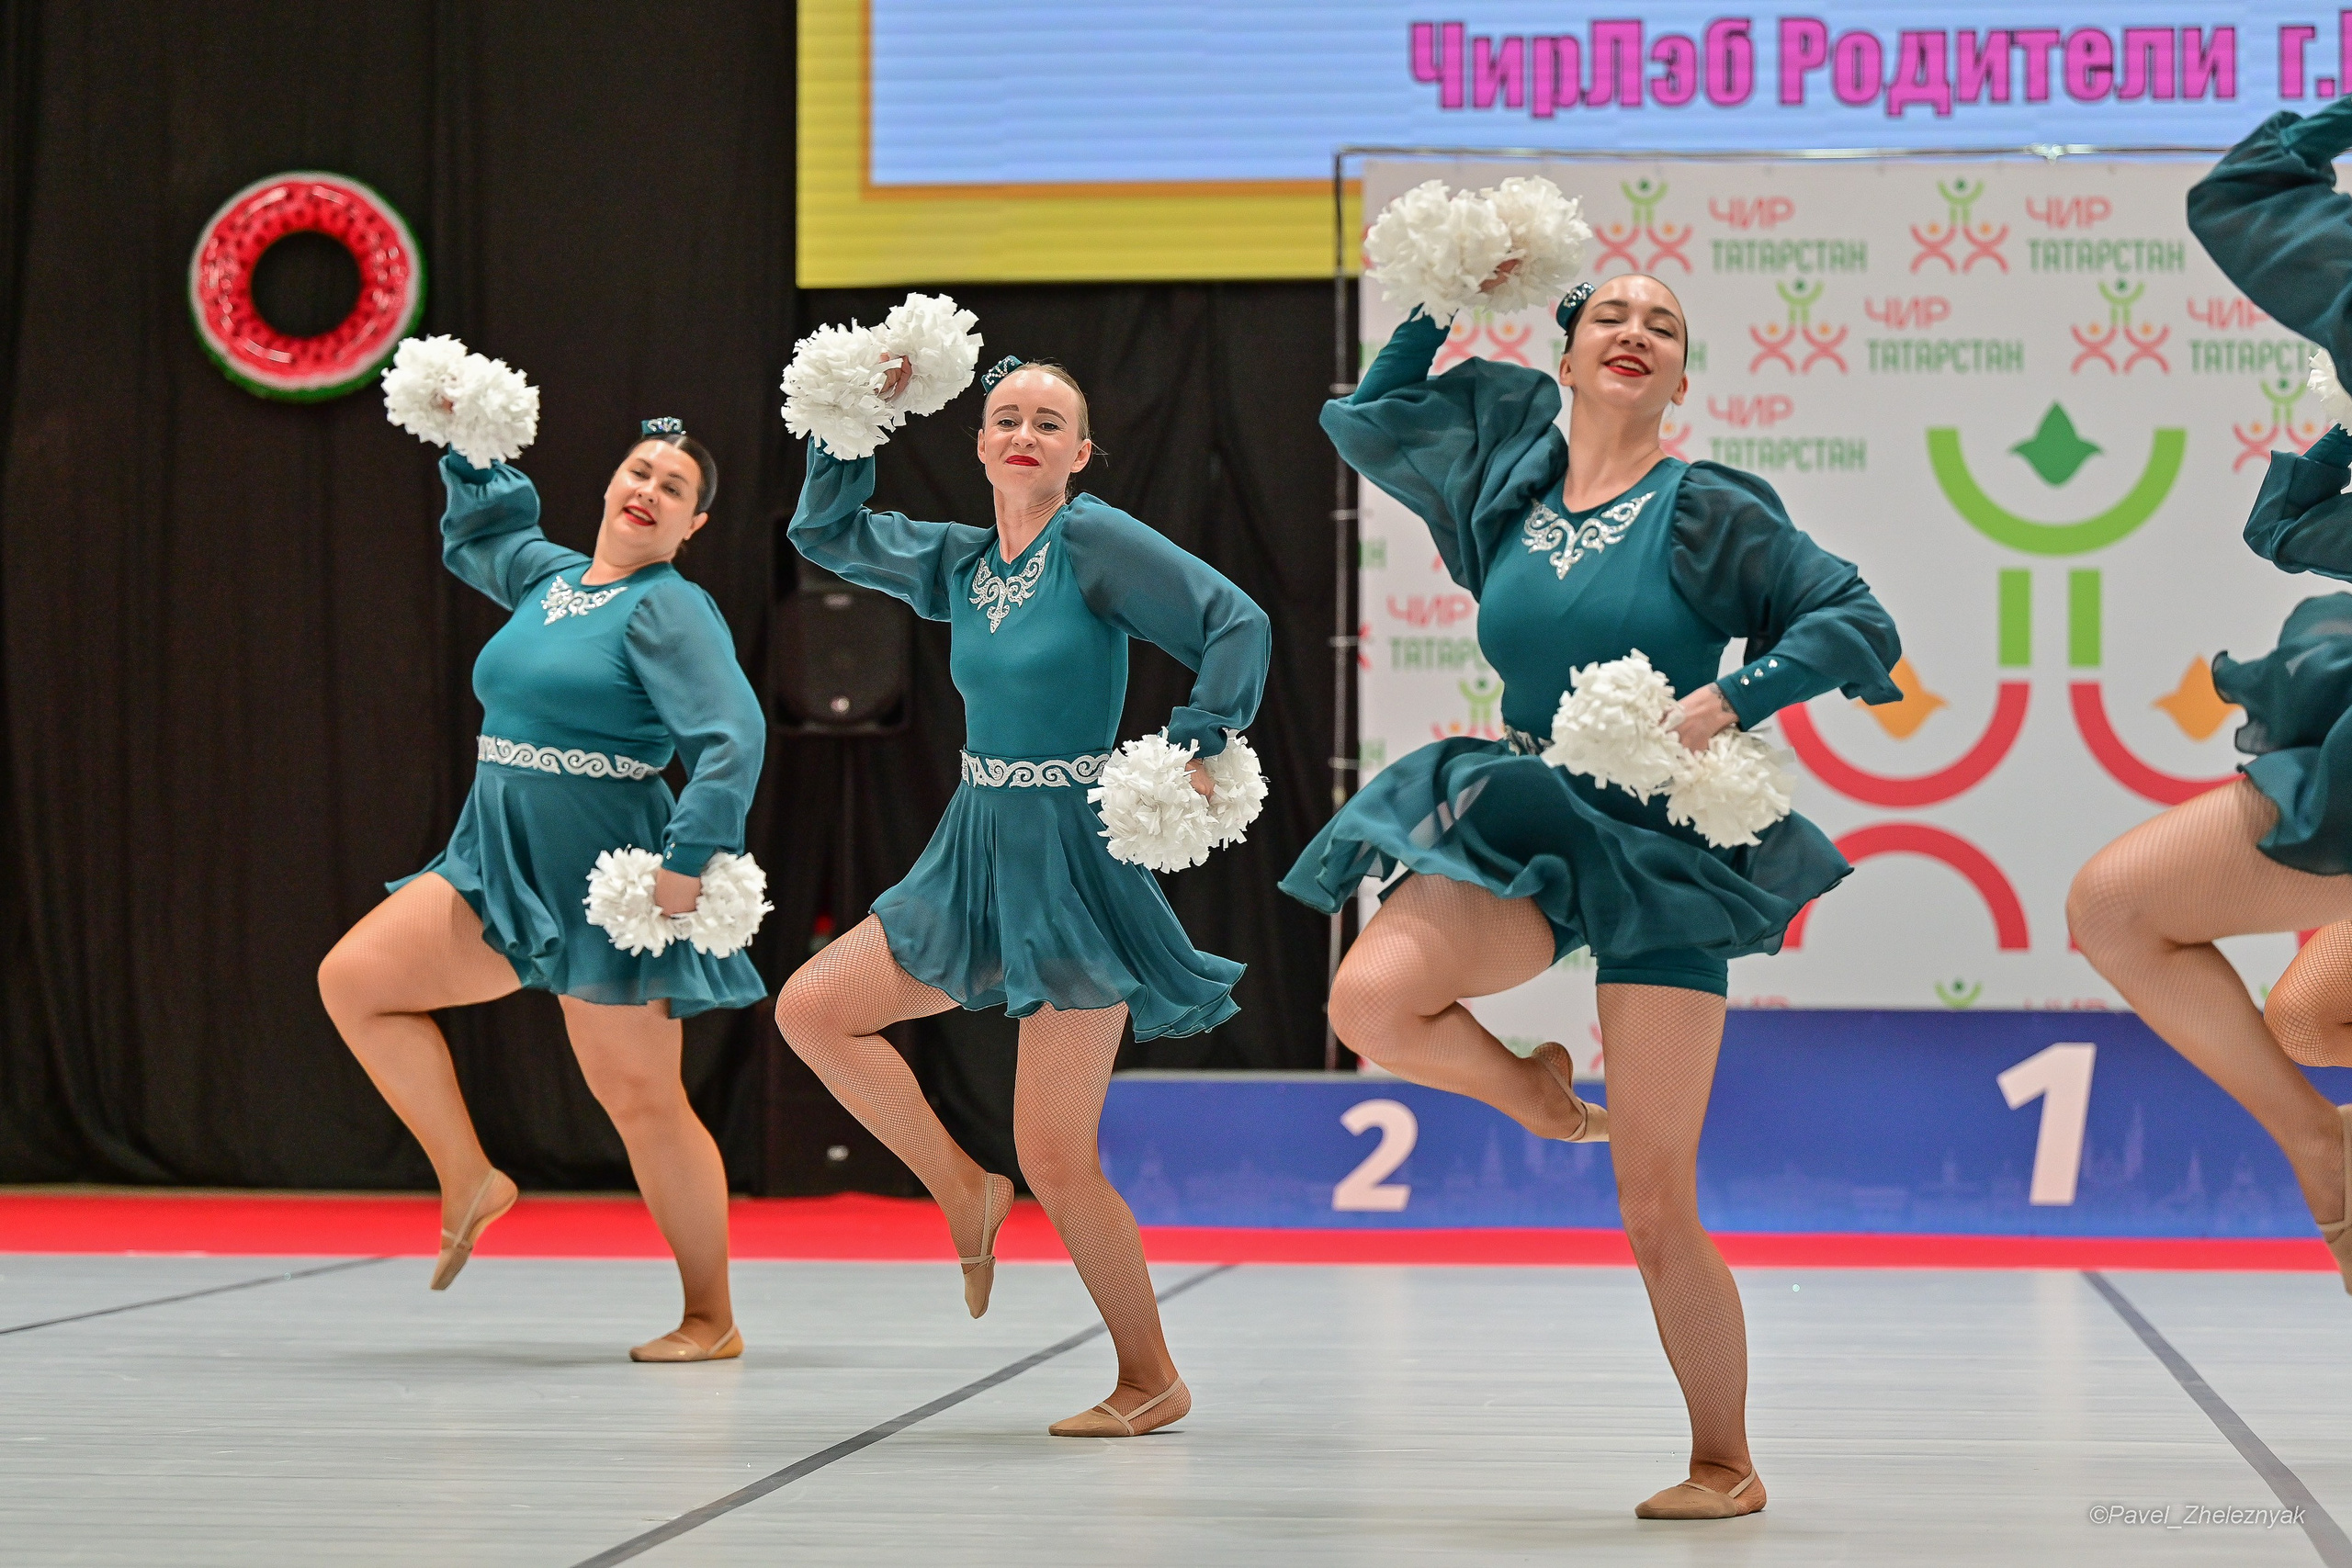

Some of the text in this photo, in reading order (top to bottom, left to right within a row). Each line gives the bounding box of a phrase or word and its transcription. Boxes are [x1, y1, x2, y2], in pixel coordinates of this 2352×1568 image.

[1409, 17, 1755, 118] ЧирЛэб
[1778, 17, 2236, 118] Родители
[1708, 196, 1796, 230] ЧИР
[2025, 196, 2113, 230] ЧИР
[1711, 239, 1869, 274] ТАТАРСТАН
[2028, 239, 2186, 273] ТАТАРСТАН
[1863, 295, 1952, 331] ЧИР
[1866, 338, 2025, 373] ТАТАРСТАН
[1707, 393, 1795, 429] ЧИР
[1711, 437, 1868, 472] ТАТАРСТАН
[1385, 593, 1474, 628] ЧИР
[1996, 1042, 2098, 1207] 1
[1332, 1098, 1419, 1213] 2
